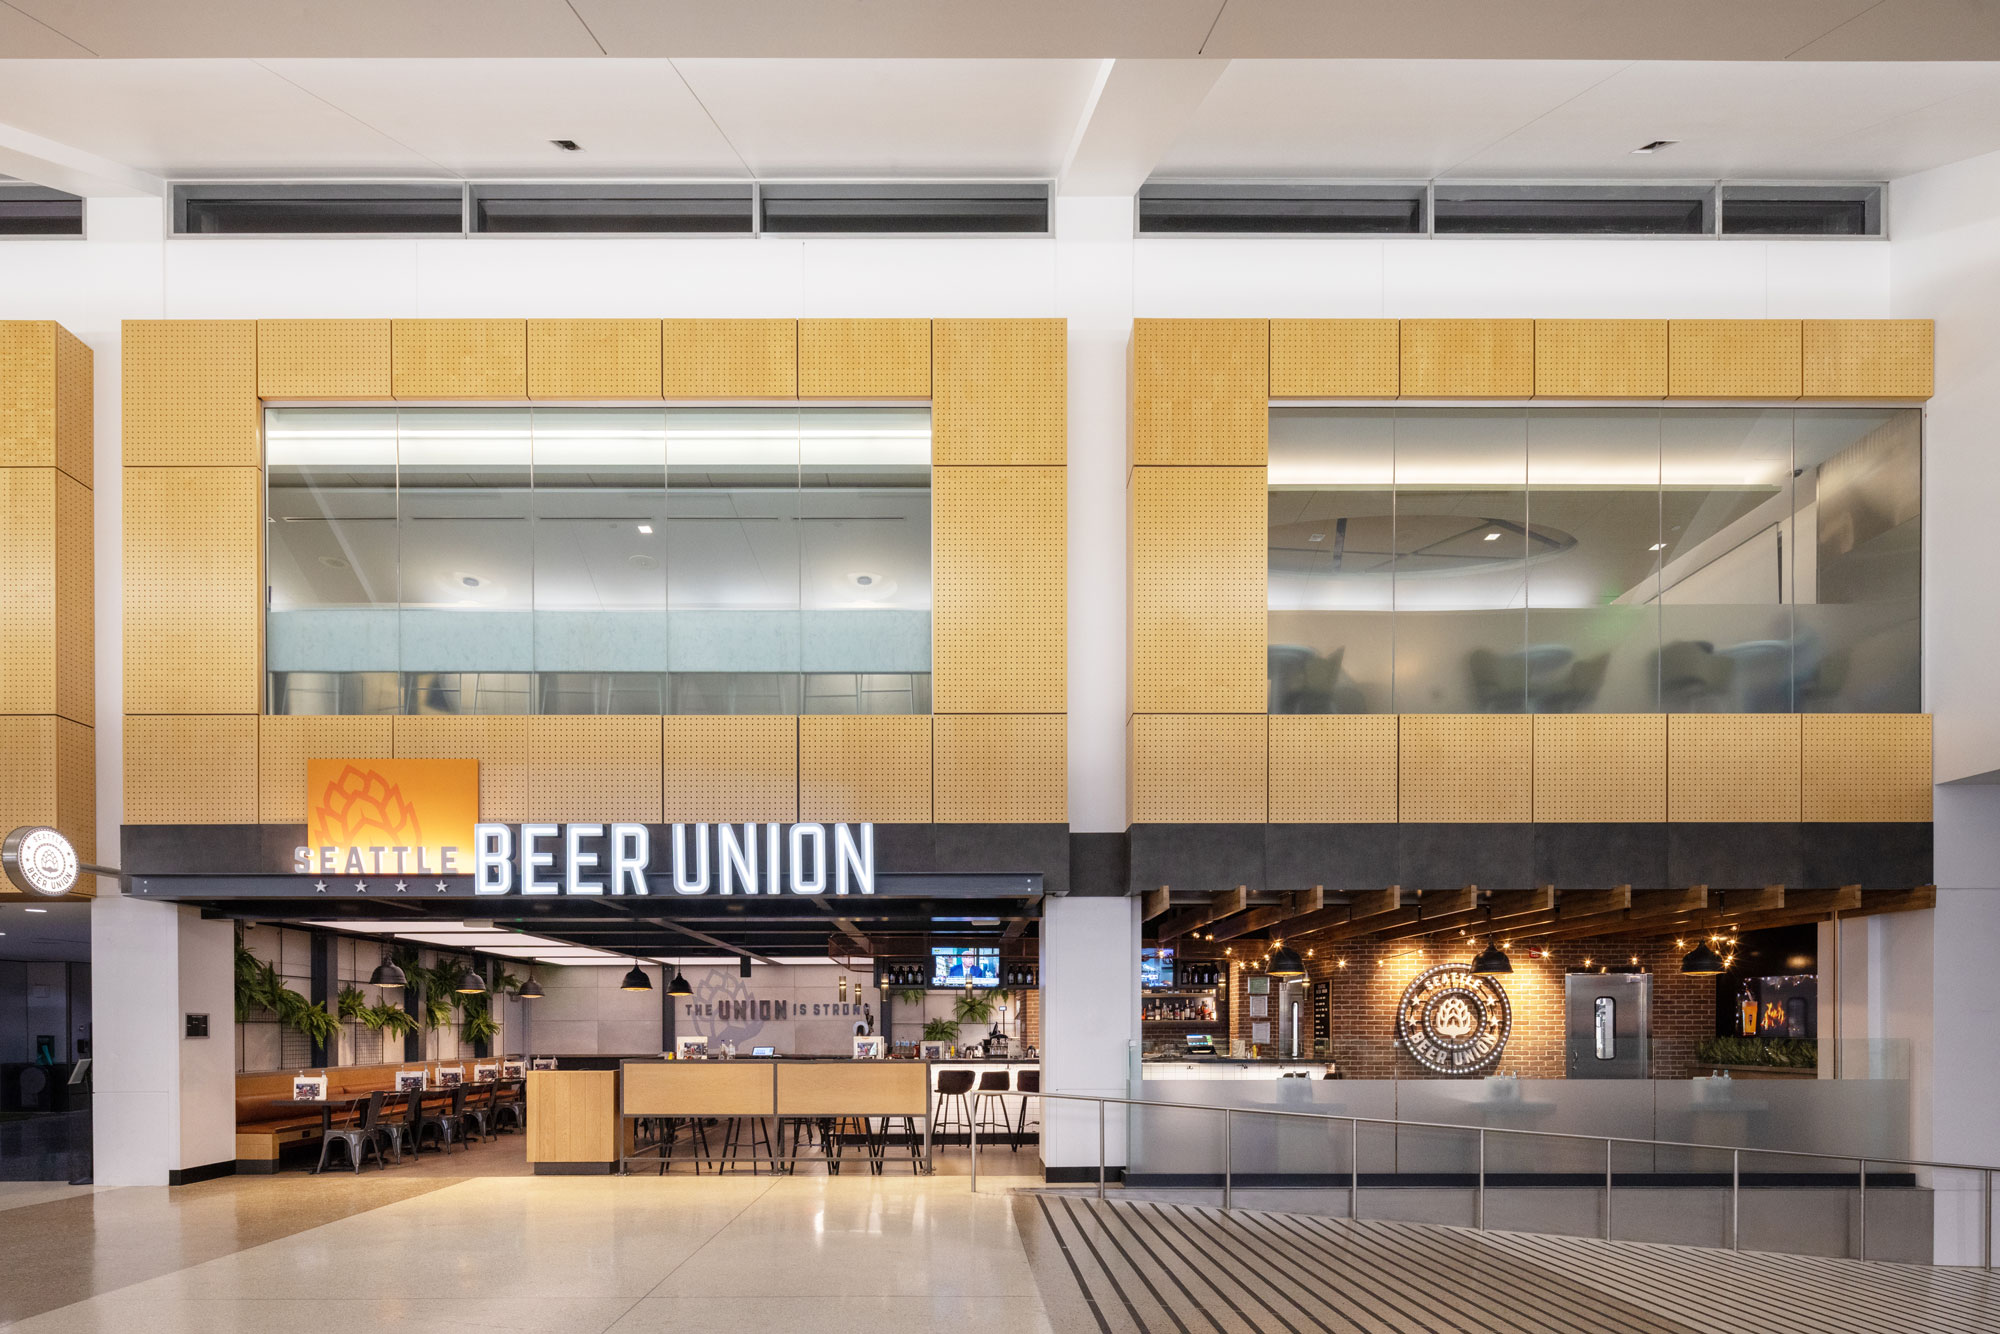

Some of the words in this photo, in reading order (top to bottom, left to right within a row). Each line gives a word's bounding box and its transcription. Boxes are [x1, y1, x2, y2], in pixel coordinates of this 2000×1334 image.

[33, 833, 63, 846] SEATTLE
[294, 846, 459, 874] SEATTLE
[474, 822, 650, 895] BEER
[672, 822, 874, 895] UNION
[27, 866, 47, 888] BEER
[51, 872, 73, 890] UNION
[1424, 972, 1483, 991] SEATTLE
[685, 1004, 713, 1016] THE
[718, 1000, 788, 1020] UNION
[793, 1003, 807, 1016] IS
[1410, 1032, 1447, 1065] BEER
[1453, 1032, 1497, 1066] UNION
